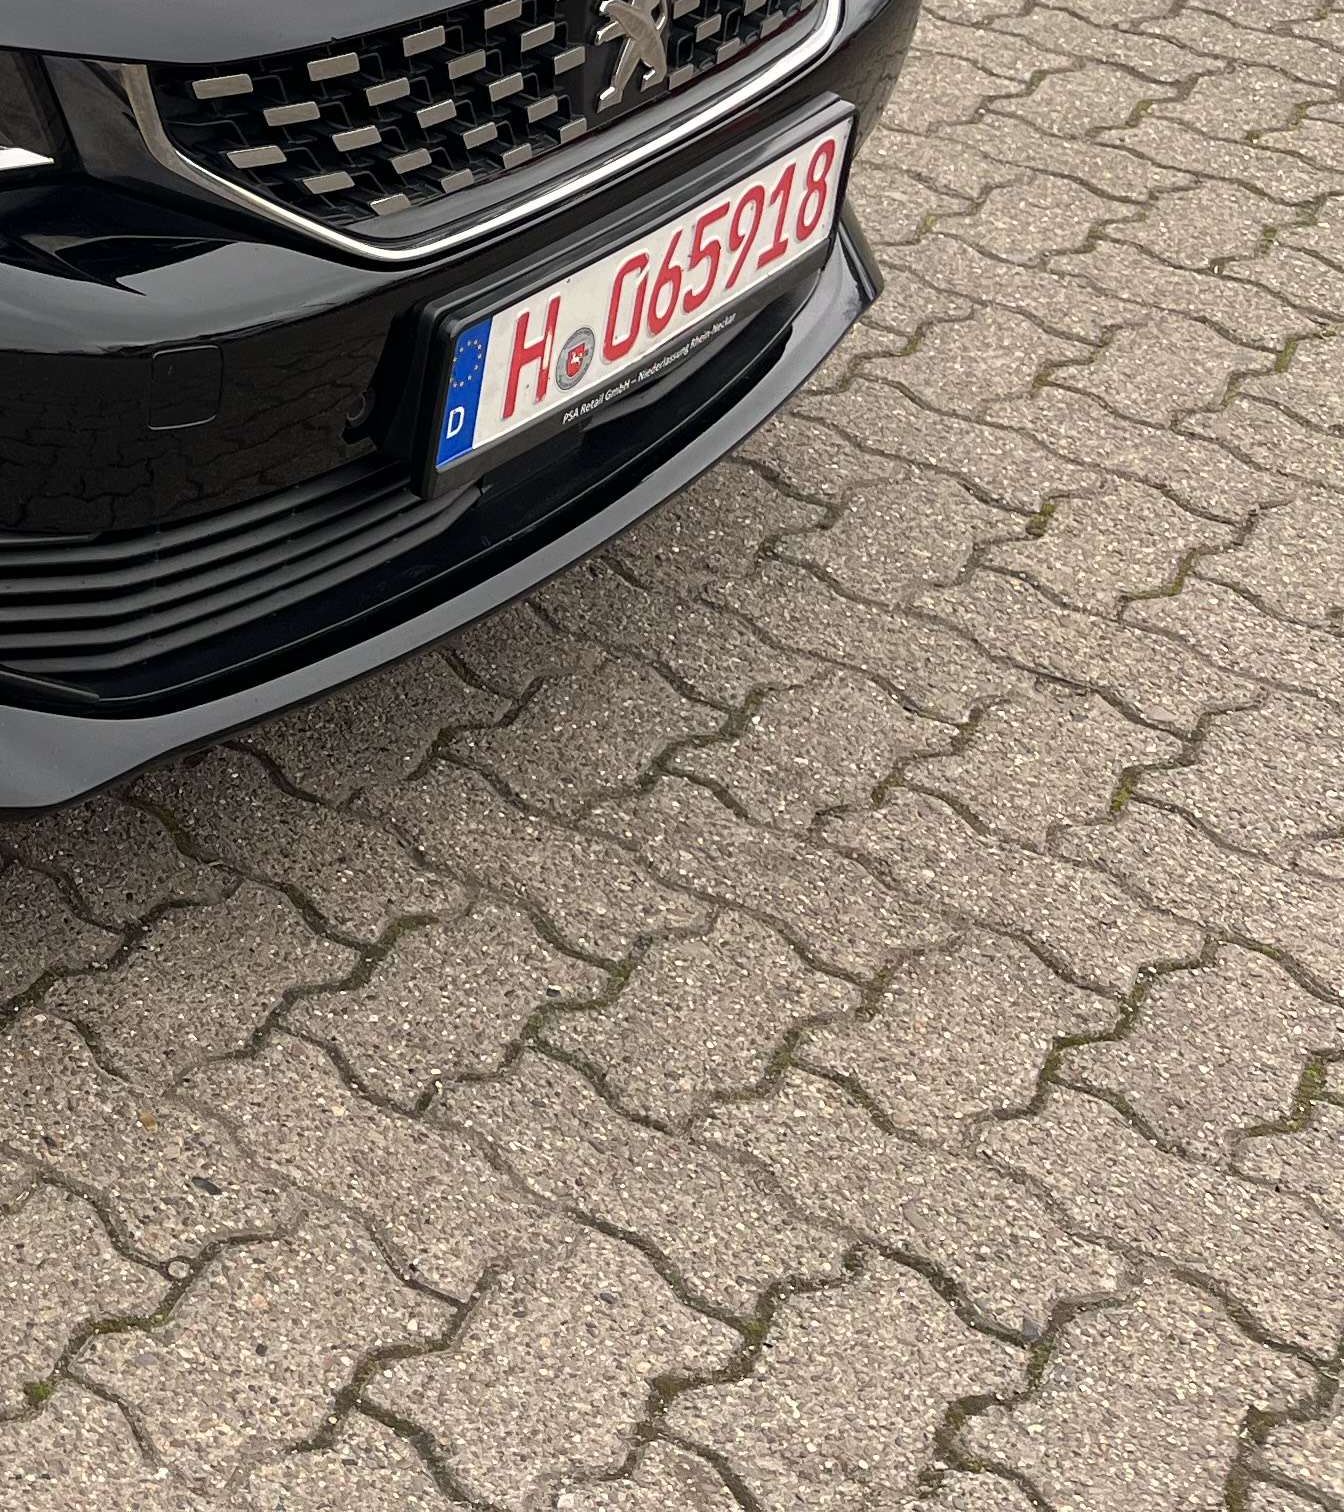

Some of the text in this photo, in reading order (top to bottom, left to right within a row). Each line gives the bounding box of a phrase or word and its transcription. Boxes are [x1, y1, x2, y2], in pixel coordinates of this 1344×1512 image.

[502, 138, 836, 419] H 065918
[446, 405, 465, 440] D
[561, 407, 579, 425] PSA
[579, 392, 604, 415] Retail
[604, 379, 631, 401] GmbH
[637, 342, 690, 382] Niederlassung
[689, 312, 737, 351] Rhein-Neckar
